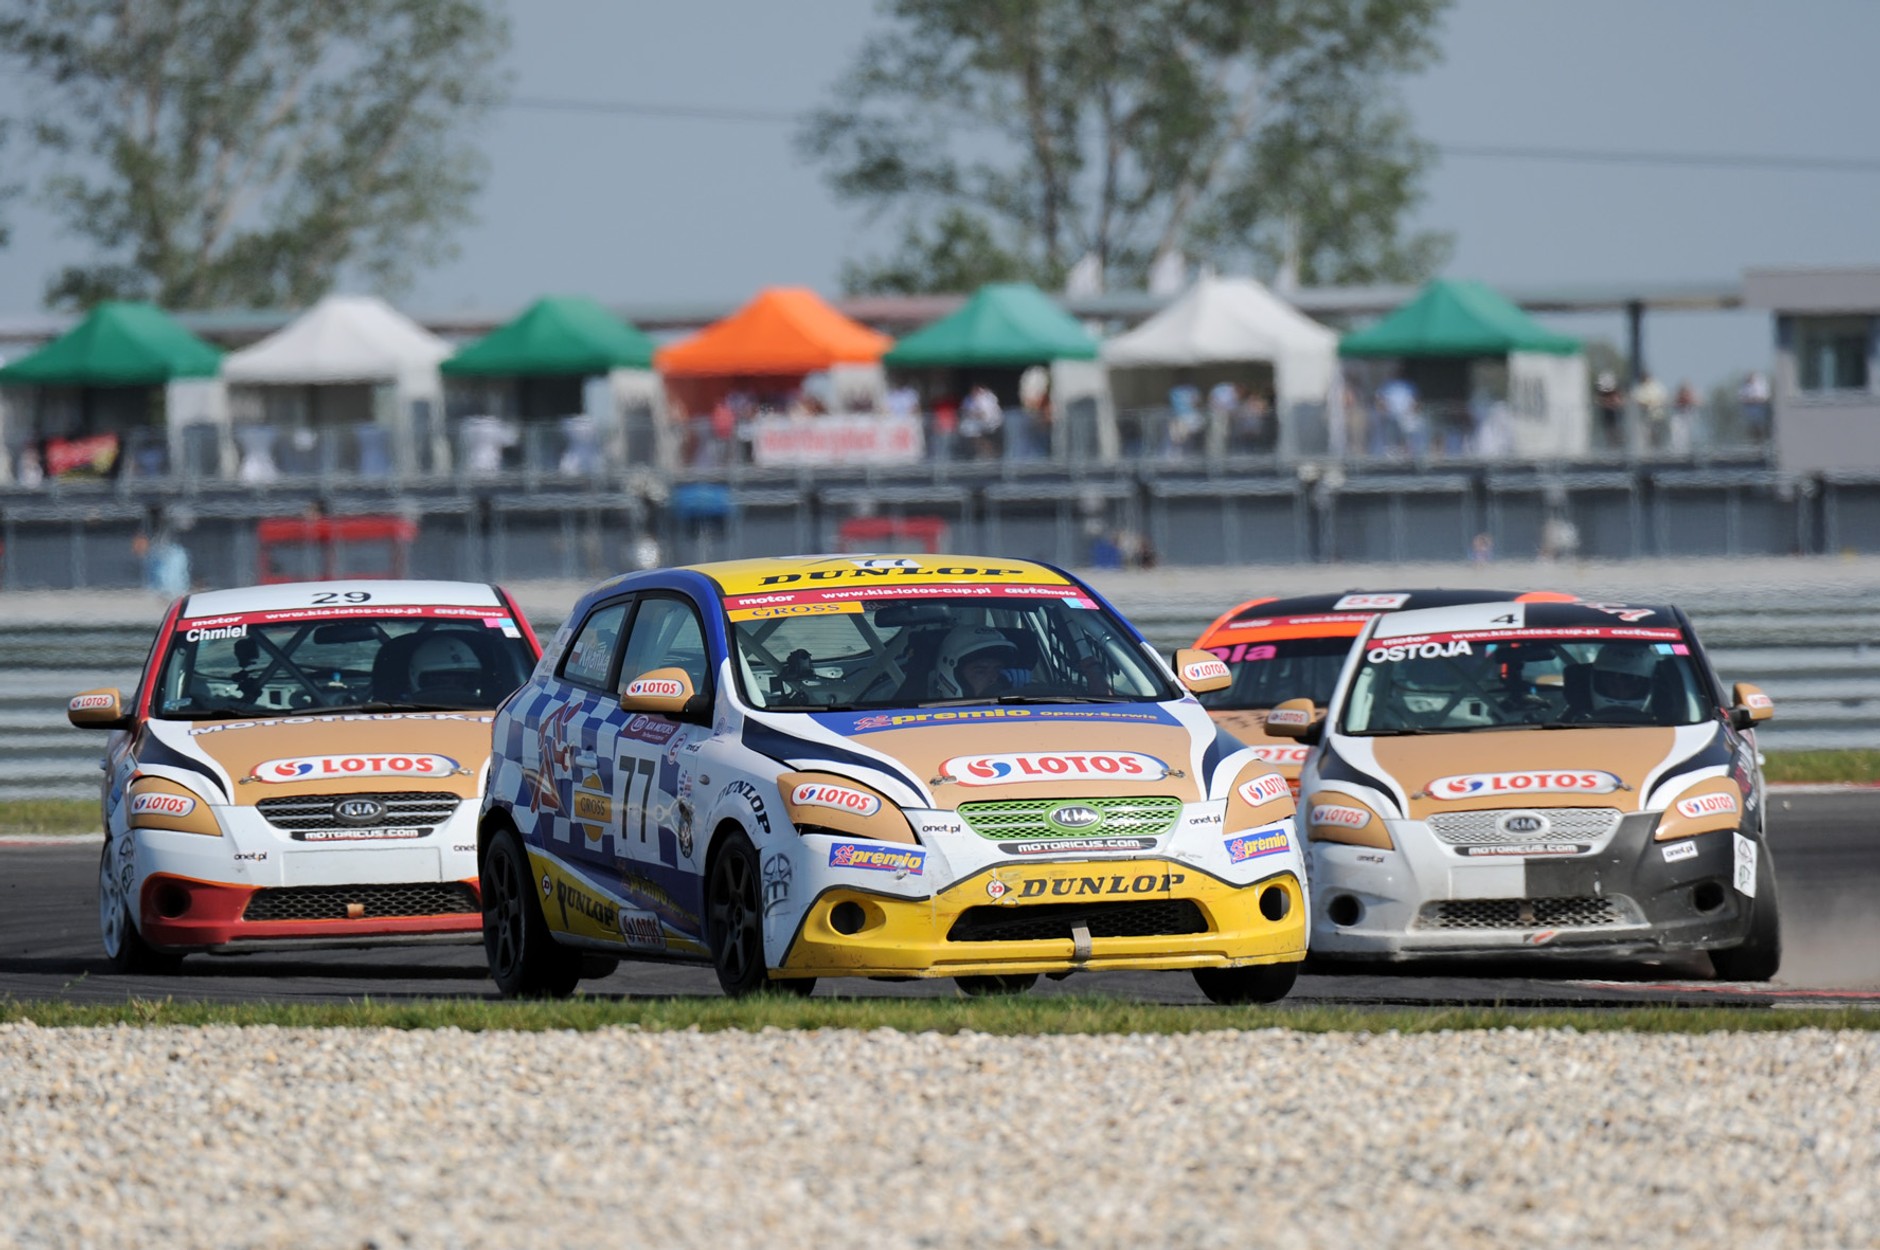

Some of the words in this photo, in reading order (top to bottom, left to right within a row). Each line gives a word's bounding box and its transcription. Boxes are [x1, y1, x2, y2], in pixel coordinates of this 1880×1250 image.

[758, 567, 1023, 585] DUNLOP
[311, 591, 371, 604] 29
[739, 594, 795, 606] motor
[822, 586, 991, 600] www.kia-lotos-cup.pl
[192, 616, 242, 626] motor
[266, 607, 422, 619] www.kia-lotos-cup.pl
[752, 603, 840, 618] GROSS
[1490, 613, 1519, 624] 4
[186, 624, 247, 642] Chmiel
[1383, 635, 1431, 646] motor
[1452, 628, 1600, 640] www.kia-lotos-cup.pl
[1367, 640, 1473, 663] OSTOJA
[1200, 662, 1226, 676] LOTOS
[642, 682, 677, 695] LOTOS
[80, 697, 109, 708] LOTOS
[890, 708, 1031, 725] premio
[322, 758, 433, 773] LOTOS
[1016, 756, 1143, 775] LOTOS
[1492, 774, 1597, 790] LOTOS
[146, 797, 187, 813] LOTOS
[580, 797, 605, 816] GROSS
[619, 755, 655, 843] 77
[816, 786, 871, 811] LOTOS
[1700, 796, 1735, 811] LOTOS
[345, 803, 375, 815] KIA
[715, 781, 771, 834] DUNLOP
[1060, 809, 1099, 823] KIA
[1325, 809, 1362, 824] LOTOS
[922, 824, 961, 835] onet.pl
[1509, 819, 1537, 830] KIA
[1244, 832, 1287, 857] premio
[234, 852, 267, 861] onet.pl
[850, 850, 922, 869] premio
[1019, 874, 1185, 898] DUNLOP
[557, 878, 615, 930] DUNLOP
